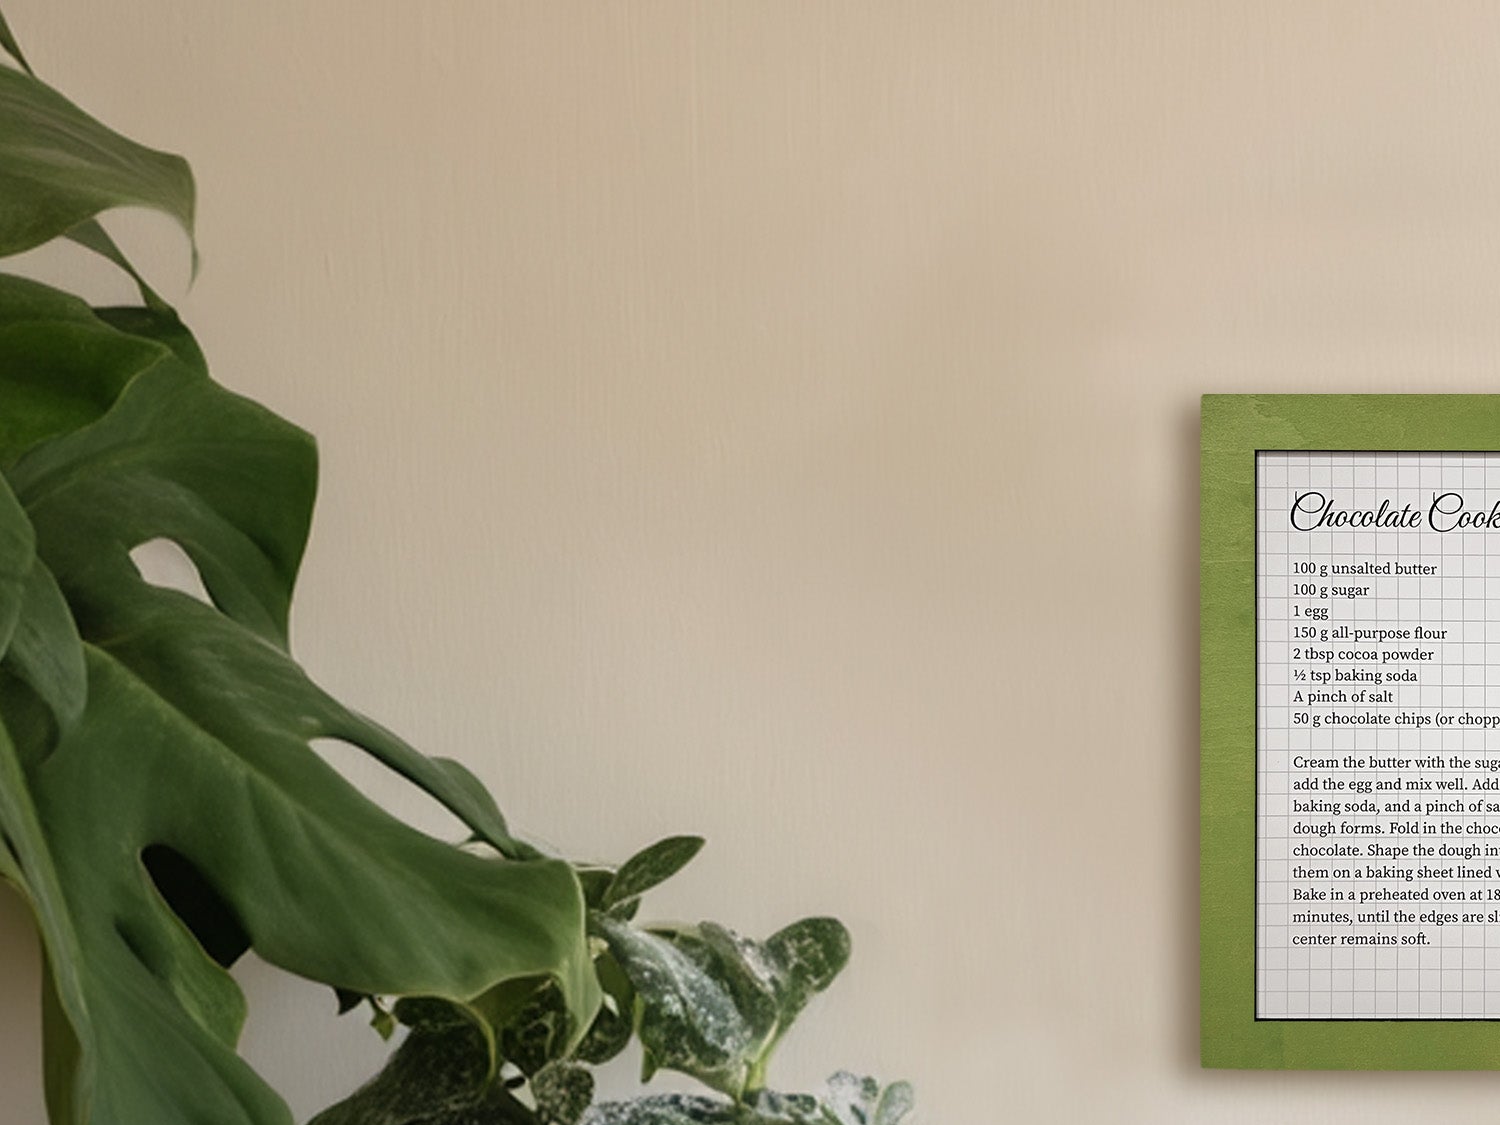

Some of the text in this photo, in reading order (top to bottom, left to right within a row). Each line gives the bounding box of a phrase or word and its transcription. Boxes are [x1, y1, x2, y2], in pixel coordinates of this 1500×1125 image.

[1290, 491, 1423, 532] Chocolate
[1293, 561, 1438, 578] 100 g unsalted butter
[1293, 583, 1370, 600] 100 g sugar
[1293, 605, 1329, 621] 1 egg
[1294, 625, 1448, 643] 150 g all-purpose flour
[1293, 646, 1435, 664] 2 tbsp cocoa powder
[1310, 670, 1332, 685] tsp
[1334, 668, 1383, 686] baking
[1385, 668, 1418, 682] soda
[1293, 689, 1393, 706] A pinch of salt
[1293, 712, 1309, 725] 50
[1312, 715, 1321, 728] g
[1324, 711, 1391, 725] chocolate
[1394, 712, 1432, 728] chips
[1435, 712, 1455, 727] (or
[1293, 755, 1339, 769] Cream
[1342, 755, 1366, 769] the
[1369, 755, 1412, 769] butter
[1414, 755, 1445, 769] with
[1449, 755, 1471, 769] the
[1293, 777, 1319, 791] add
[1322, 777, 1345, 791] the
[1348, 781, 1373, 794] egg
[1375, 777, 1402, 791] and
[1406, 777, 1432, 790] mix
[1435, 777, 1468, 791] well.
[1471, 777, 1500, 791] Add
[1293, 799, 1341, 816] baking
[1344, 799, 1381, 816] soda,
[1384, 799, 1411, 813] and
[1414, 803, 1422, 813] a
[1425, 799, 1465, 816] pinch
[1468, 799, 1484, 813] of
[1293, 821, 1336, 838] dough
[1340, 820, 1385, 835] forms.
[1389, 821, 1420, 835] Fold
[1423, 821, 1437, 834] in
[1440, 821, 1463, 835] the
[1292, 843, 1364, 857] chocolate.
[1367, 843, 1409, 860] Shape
[1412, 843, 1435, 857] the
[1438, 843, 1481, 860] dough
[1292, 865, 1329, 879] them
[1332, 869, 1351, 879] on
[1354, 869, 1363, 879] a
[1366, 865, 1414, 882] baking
[1416, 865, 1454, 879] sheet
[1457, 865, 1492, 879] lined
[1293, 887, 1327, 901] Bake
[1330, 887, 1344, 901] in
[1347, 891, 1356, 901] a
[1359, 887, 1429, 905] preheated
[1432, 891, 1466, 901] oven
[1469, 889, 1483, 901] at
[1292, 909, 1353, 927] minutes,
[1357, 909, 1390, 923] until
[1393, 909, 1416, 923] the
[1419, 909, 1459, 927] edges
[1462, 913, 1484, 923] are
[1292, 931, 1431, 946] center remains soft.
